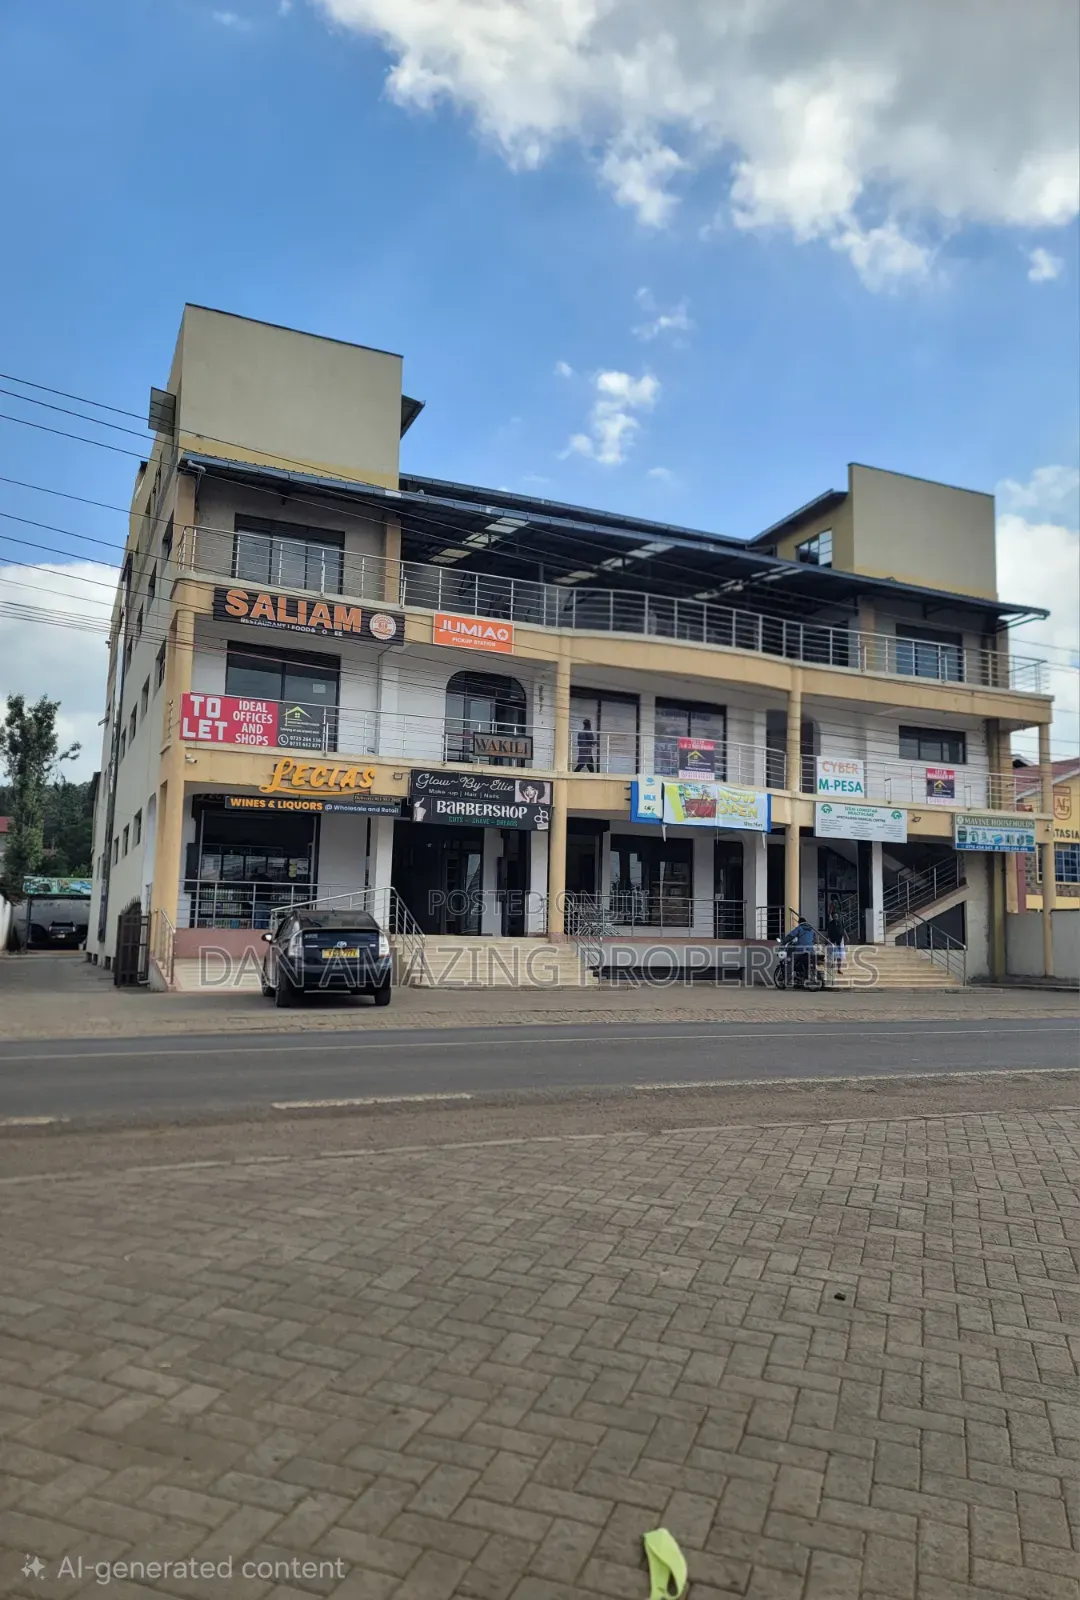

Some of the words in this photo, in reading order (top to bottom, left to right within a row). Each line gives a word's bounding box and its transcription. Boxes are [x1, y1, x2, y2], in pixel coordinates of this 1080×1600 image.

[225, 589, 362, 633] SALIAM
[452, 636, 473, 644] PICKUP
[474, 639, 496, 647] STATION
[190, 694, 221, 719] TO
[239, 700, 268, 713] IDEAL
[233, 710, 273, 724] OFFICES
[182, 717, 228, 740] LET
[241, 722, 264, 734] AND
[234, 733, 269, 746] SHOPS
[475, 738, 528, 754] WAKILI
[822, 760, 859, 774] CYBER
[818, 778, 863, 793] M-PESA
[230, 797, 266, 808] WINES
[268, 798, 275, 808] &
[277, 800, 323, 811] LIQUORS
[324, 803, 333, 811] @
[334, 804, 367, 813] Wholesale
[717, 801, 758, 818] OPEN
[471, 817, 490, 825] SHAVE
[496, 819, 518, 827] DREADS
[964, 816, 991, 825] MAVINE
[991, 818, 1034, 828] HOUSEHOLDS
[1053, 828, 1080, 840] TASIA
